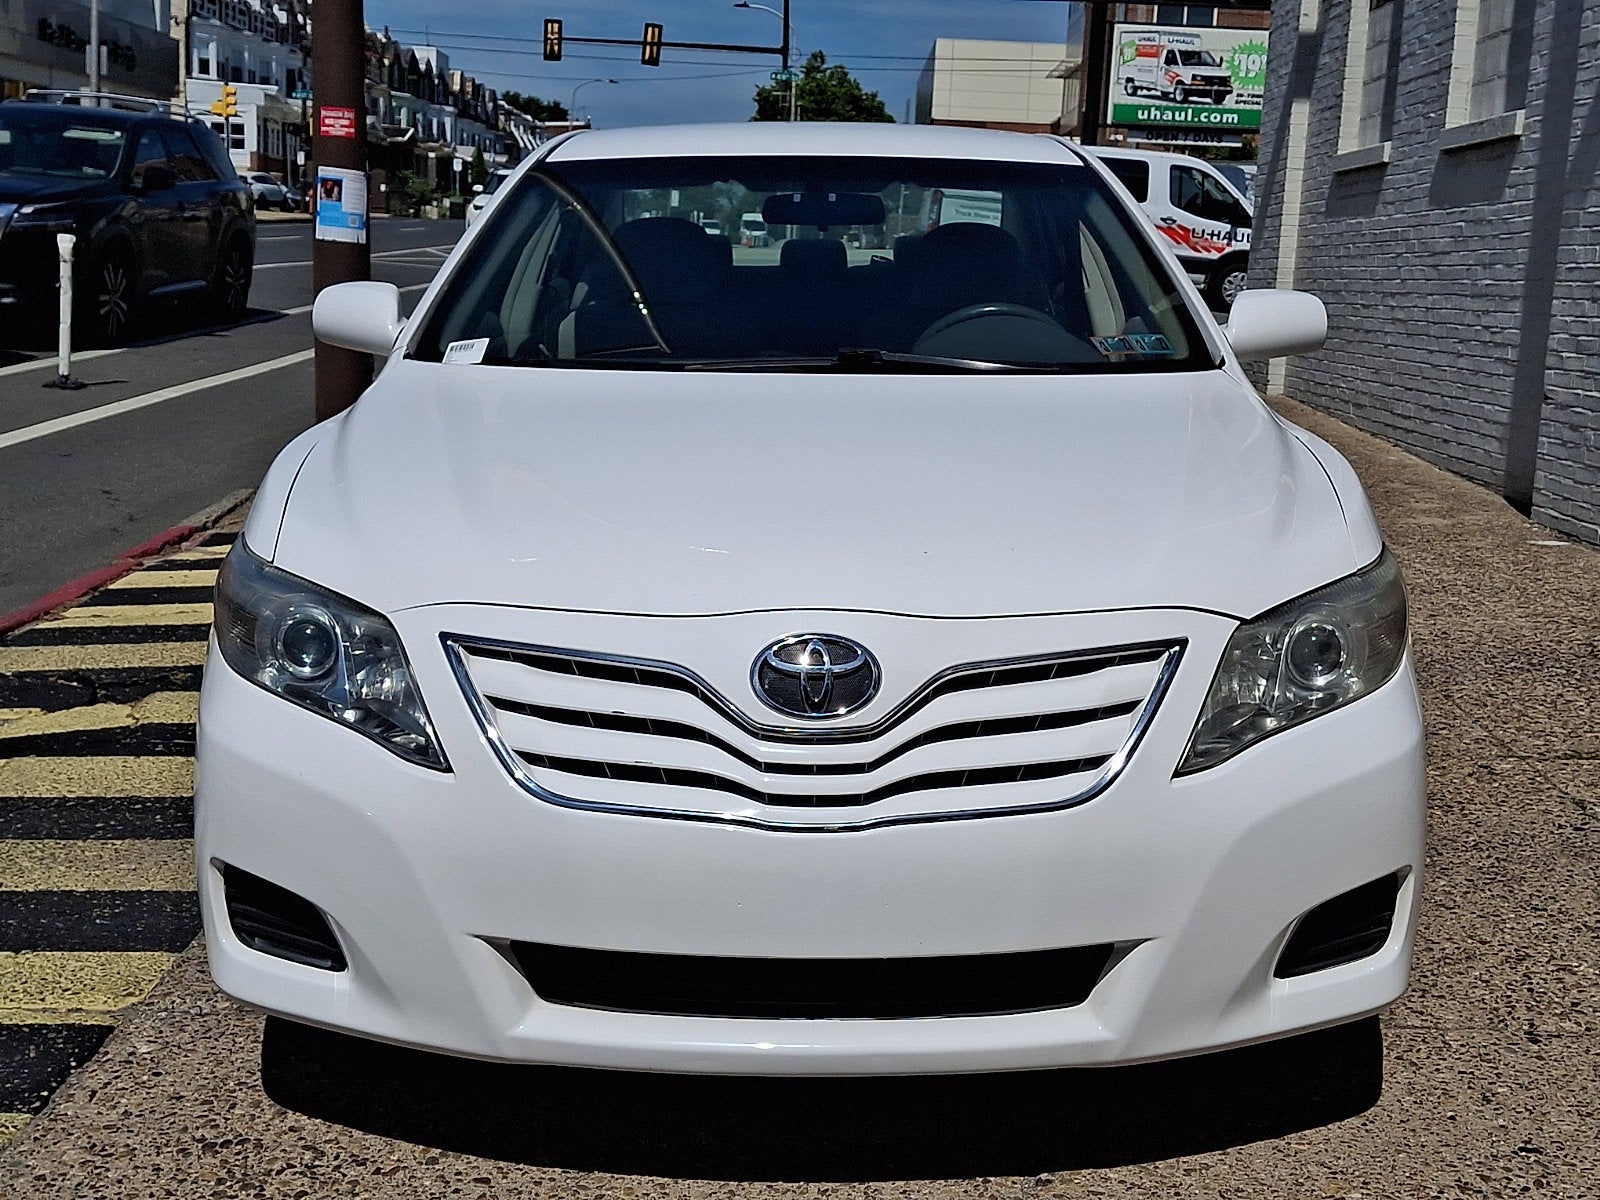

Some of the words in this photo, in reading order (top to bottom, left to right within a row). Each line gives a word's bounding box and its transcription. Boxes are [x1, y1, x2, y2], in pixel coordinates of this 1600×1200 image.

[1137, 107, 1239, 124] uhaul.com
[1145, 131, 1178, 142] OPEN
[1193, 133, 1223, 144] DAYS
